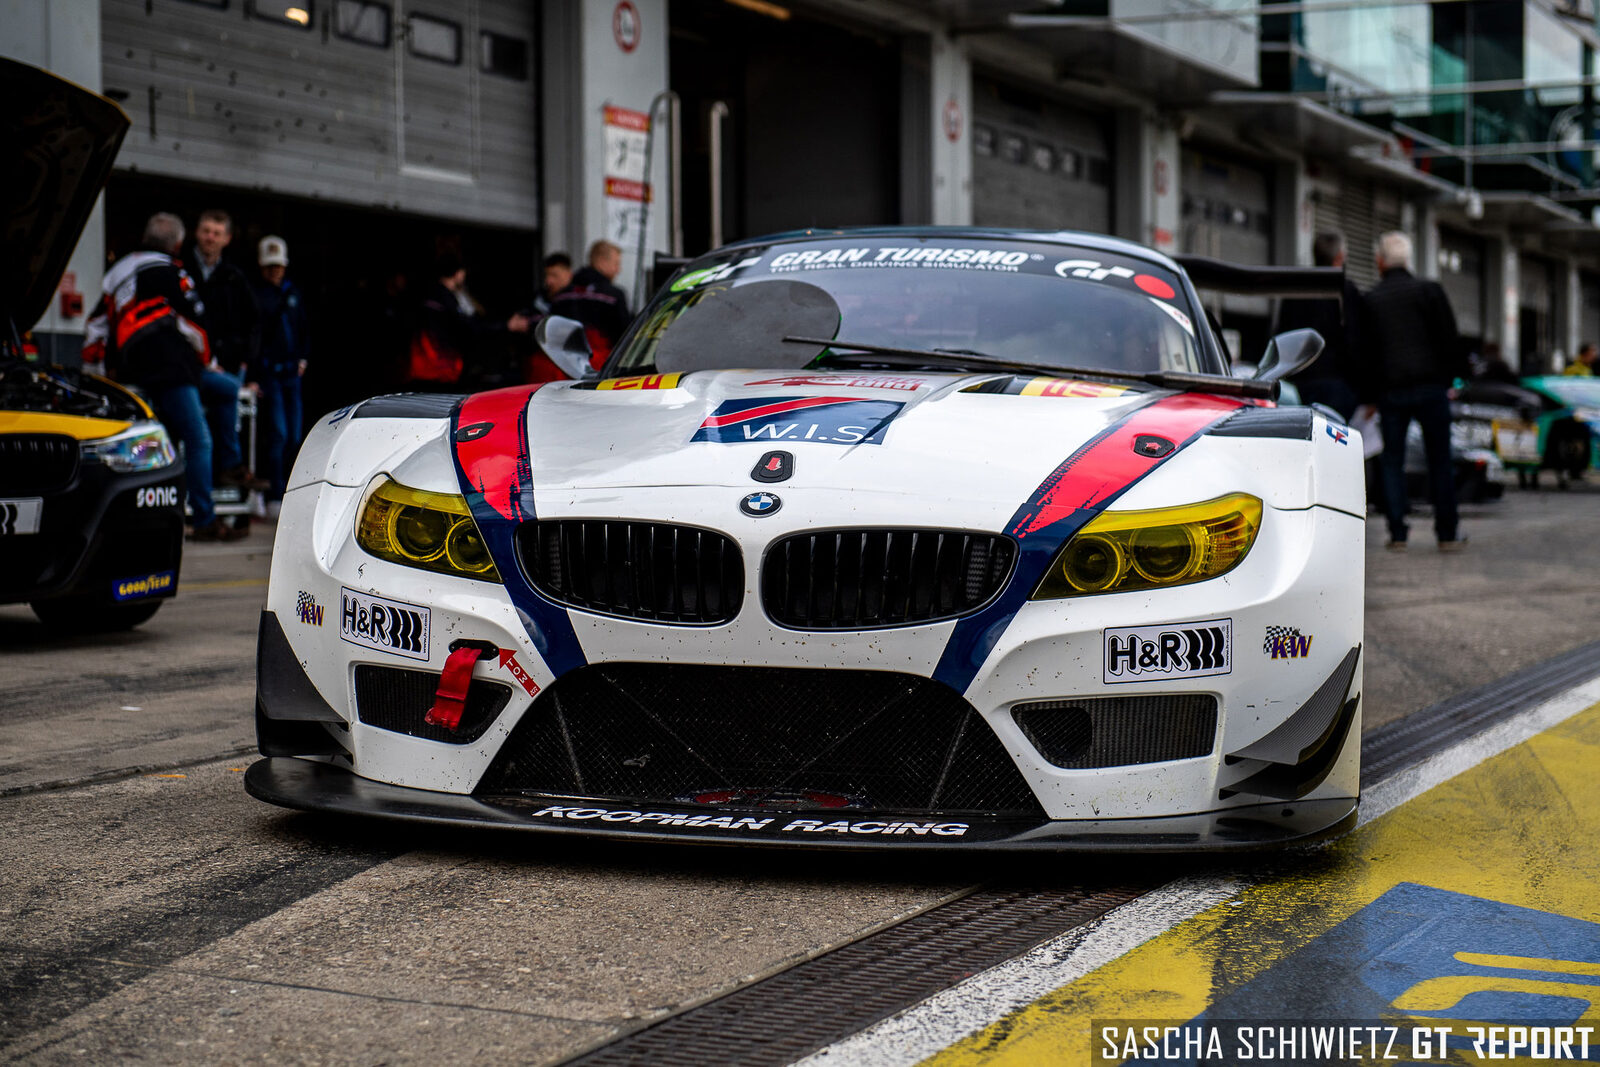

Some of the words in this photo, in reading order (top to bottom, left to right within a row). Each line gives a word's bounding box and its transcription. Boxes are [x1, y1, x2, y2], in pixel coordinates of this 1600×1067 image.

[769, 248, 870, 268] GRAN
[770, 265, 799, 273] THE
[804, 262, 846, 271] REAL
[922, 261, 1019, 273] SIMULATOR
[742, 423, 874, 442] W.I.S.
[136, 486, 178, 508] SONIC
[119, 575, 171, 596] GOODYEAR
[301, 603, 325, 627] KW
[342, 595, 390, 645] H&R
[1108, 632, 1188, 676] H&R
[1271, 635, 1313, 660] KW
[506, 658, 528, 684] TOW
[532, 806, 774, 830] KOOPMAN
[782, 819, 969, 836] RACING
